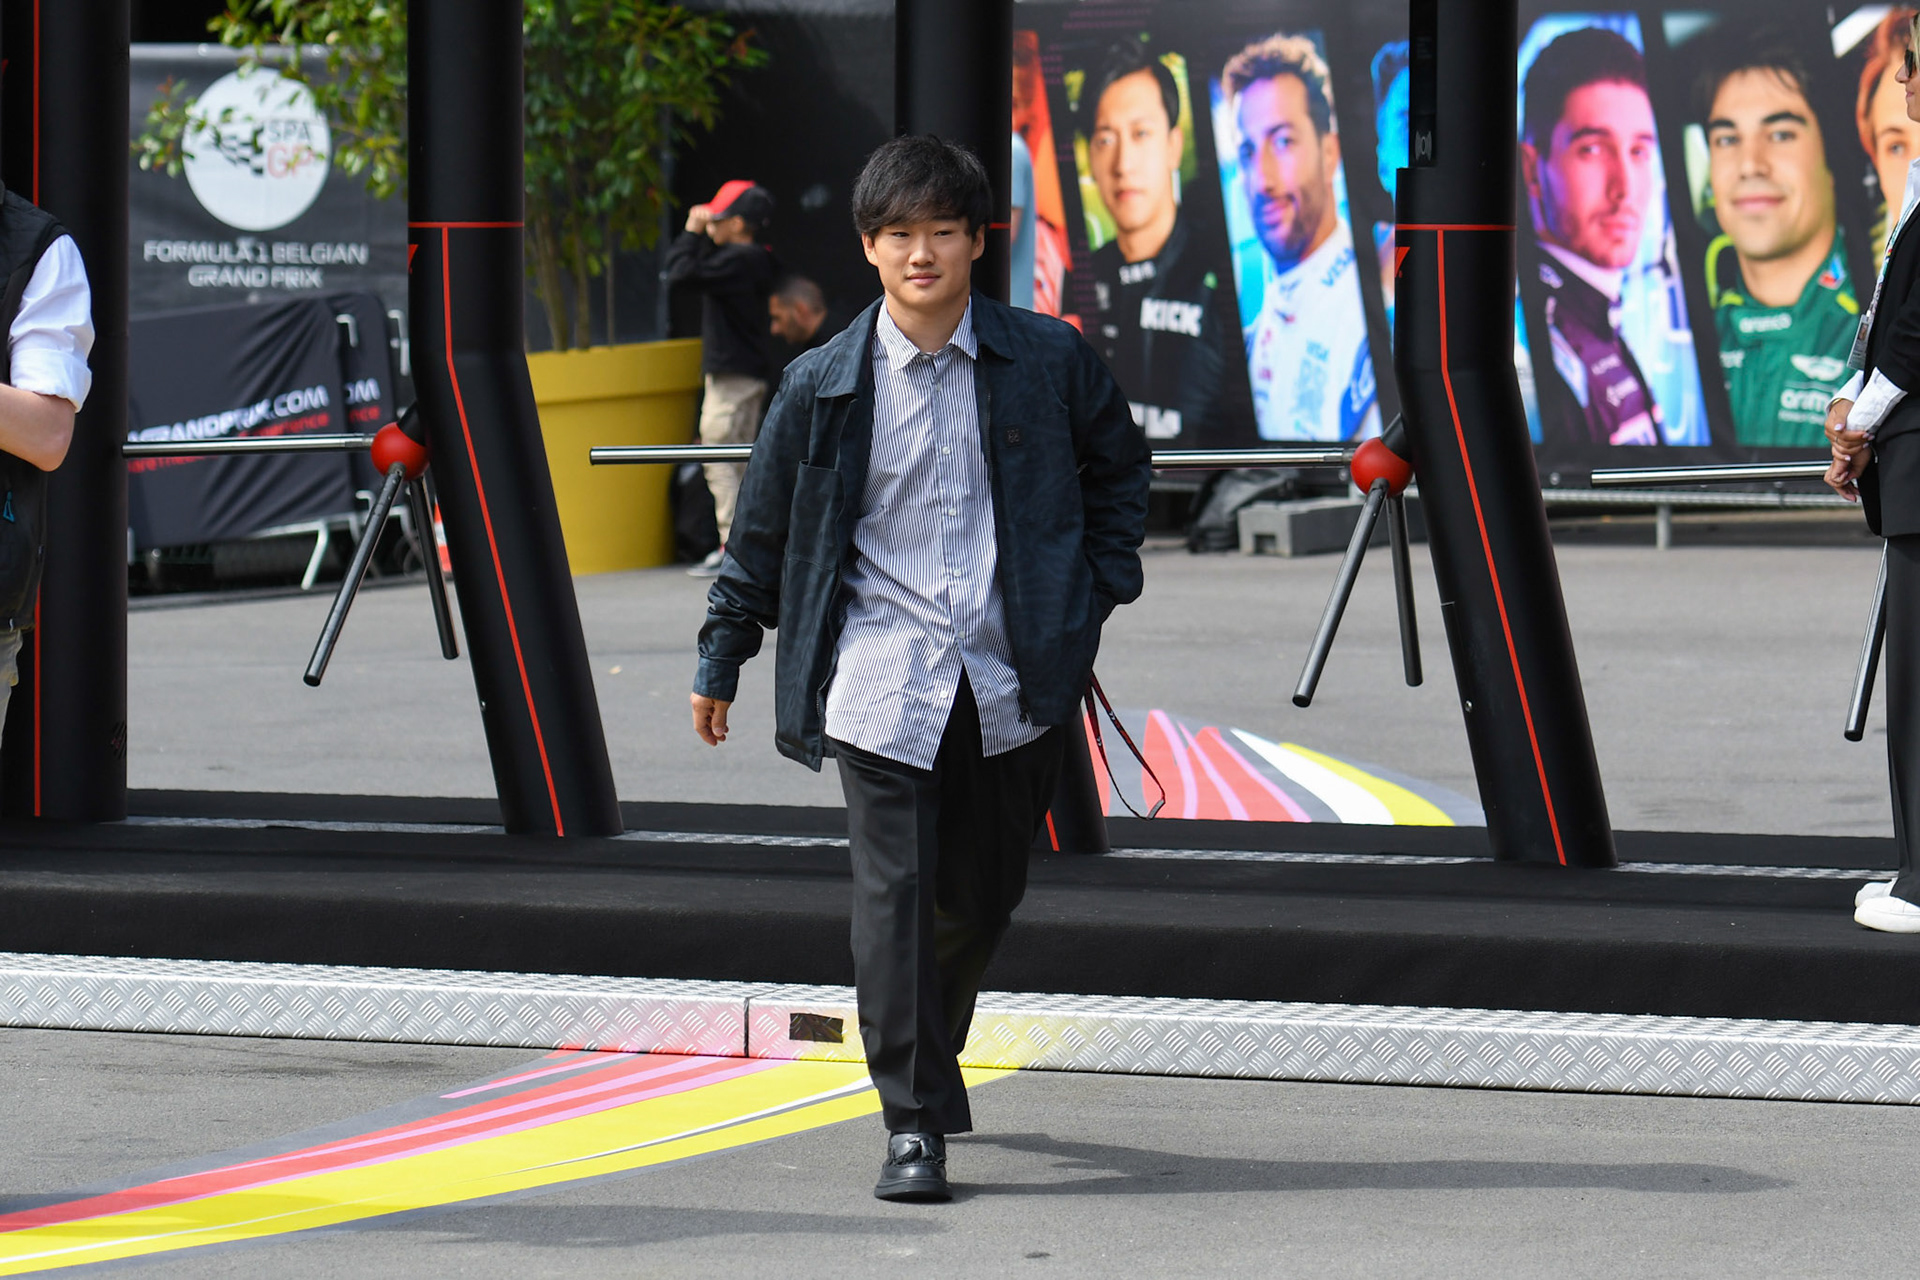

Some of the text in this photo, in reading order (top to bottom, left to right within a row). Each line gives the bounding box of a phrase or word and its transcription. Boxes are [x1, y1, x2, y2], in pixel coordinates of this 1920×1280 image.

[267, 120, 312, 142] SPA
[266, 144, 314, 178] GP
[143, 239, 369, 265] FORMULA 1 BELGIAN
[188, 264, 324, 289] GRAND PRIX
[1140, 298, 1203, 338] KICK
